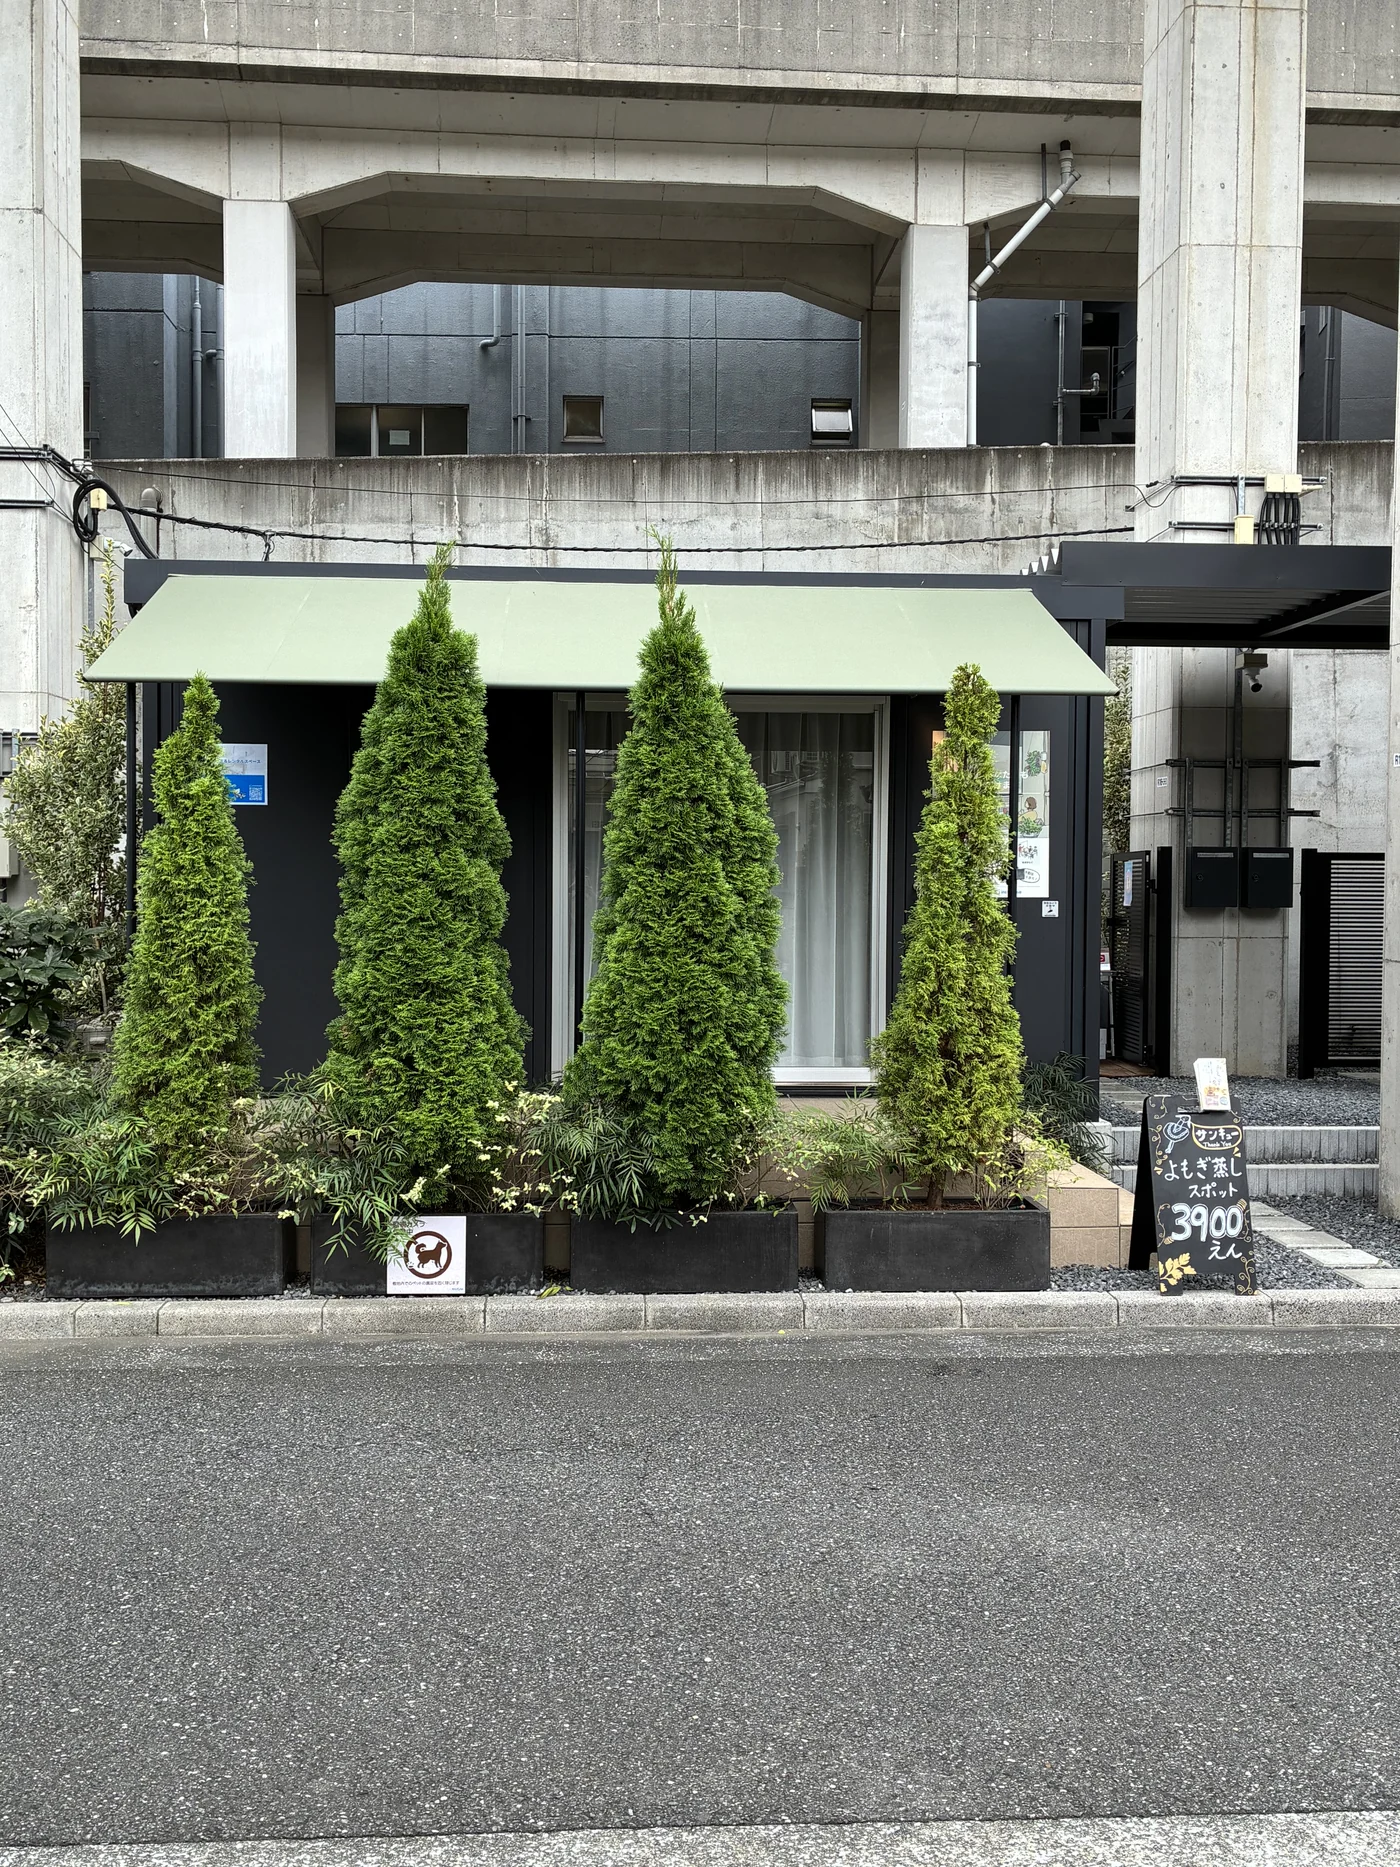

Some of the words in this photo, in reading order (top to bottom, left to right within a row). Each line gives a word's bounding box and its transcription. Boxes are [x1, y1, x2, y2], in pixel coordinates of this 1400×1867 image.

[1195, 1128, 1239, 1142] サンキュー
[1164, 1156, 1243, 1181] よもぎ蒸し
[1188, 1181, 1239, 1198] スポット
[1171, 1202, 1244, 1242] 3900
[1208, 1240, 1243, 1260] えん
